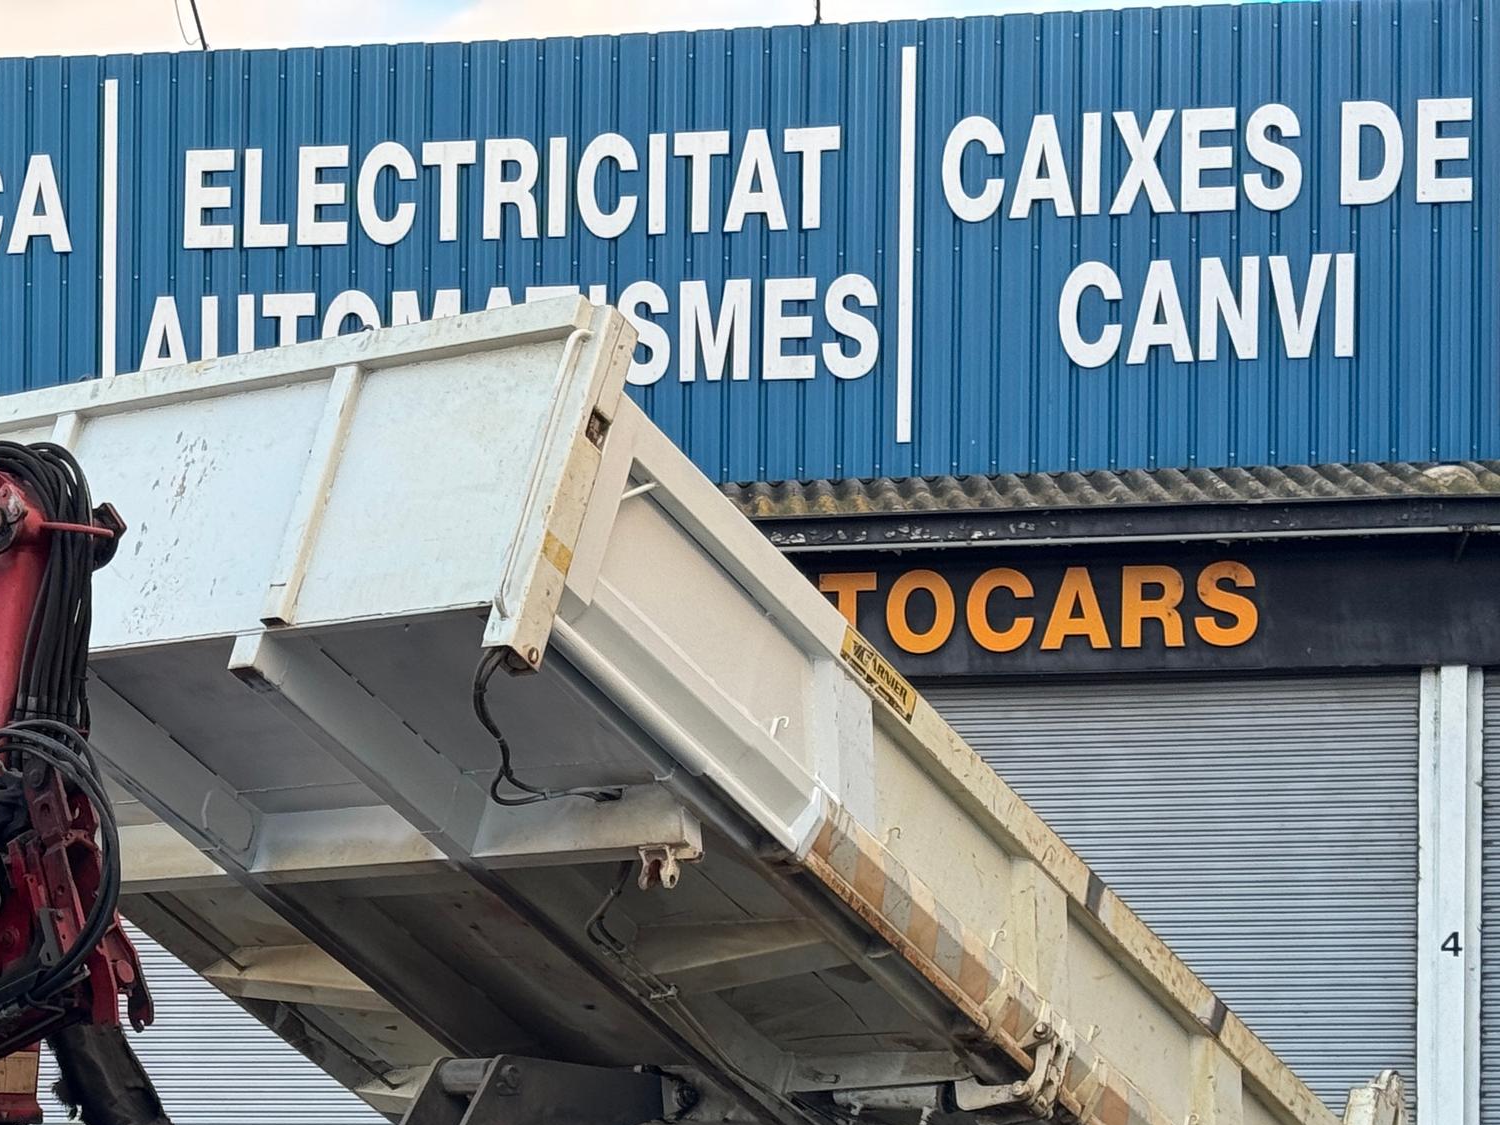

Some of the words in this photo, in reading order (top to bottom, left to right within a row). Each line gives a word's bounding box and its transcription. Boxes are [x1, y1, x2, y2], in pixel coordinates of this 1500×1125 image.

[184, 125, 841, 249] ELECTRICITAT
[942, 103, 1303, 223] CAIXES
[1340, 97, 1473, 206] DE
[140, 273, 879, 386] AUTSMES
[1058, 252, 1355, 368] CANVI
[1441, 932, 1462, 957] 4
